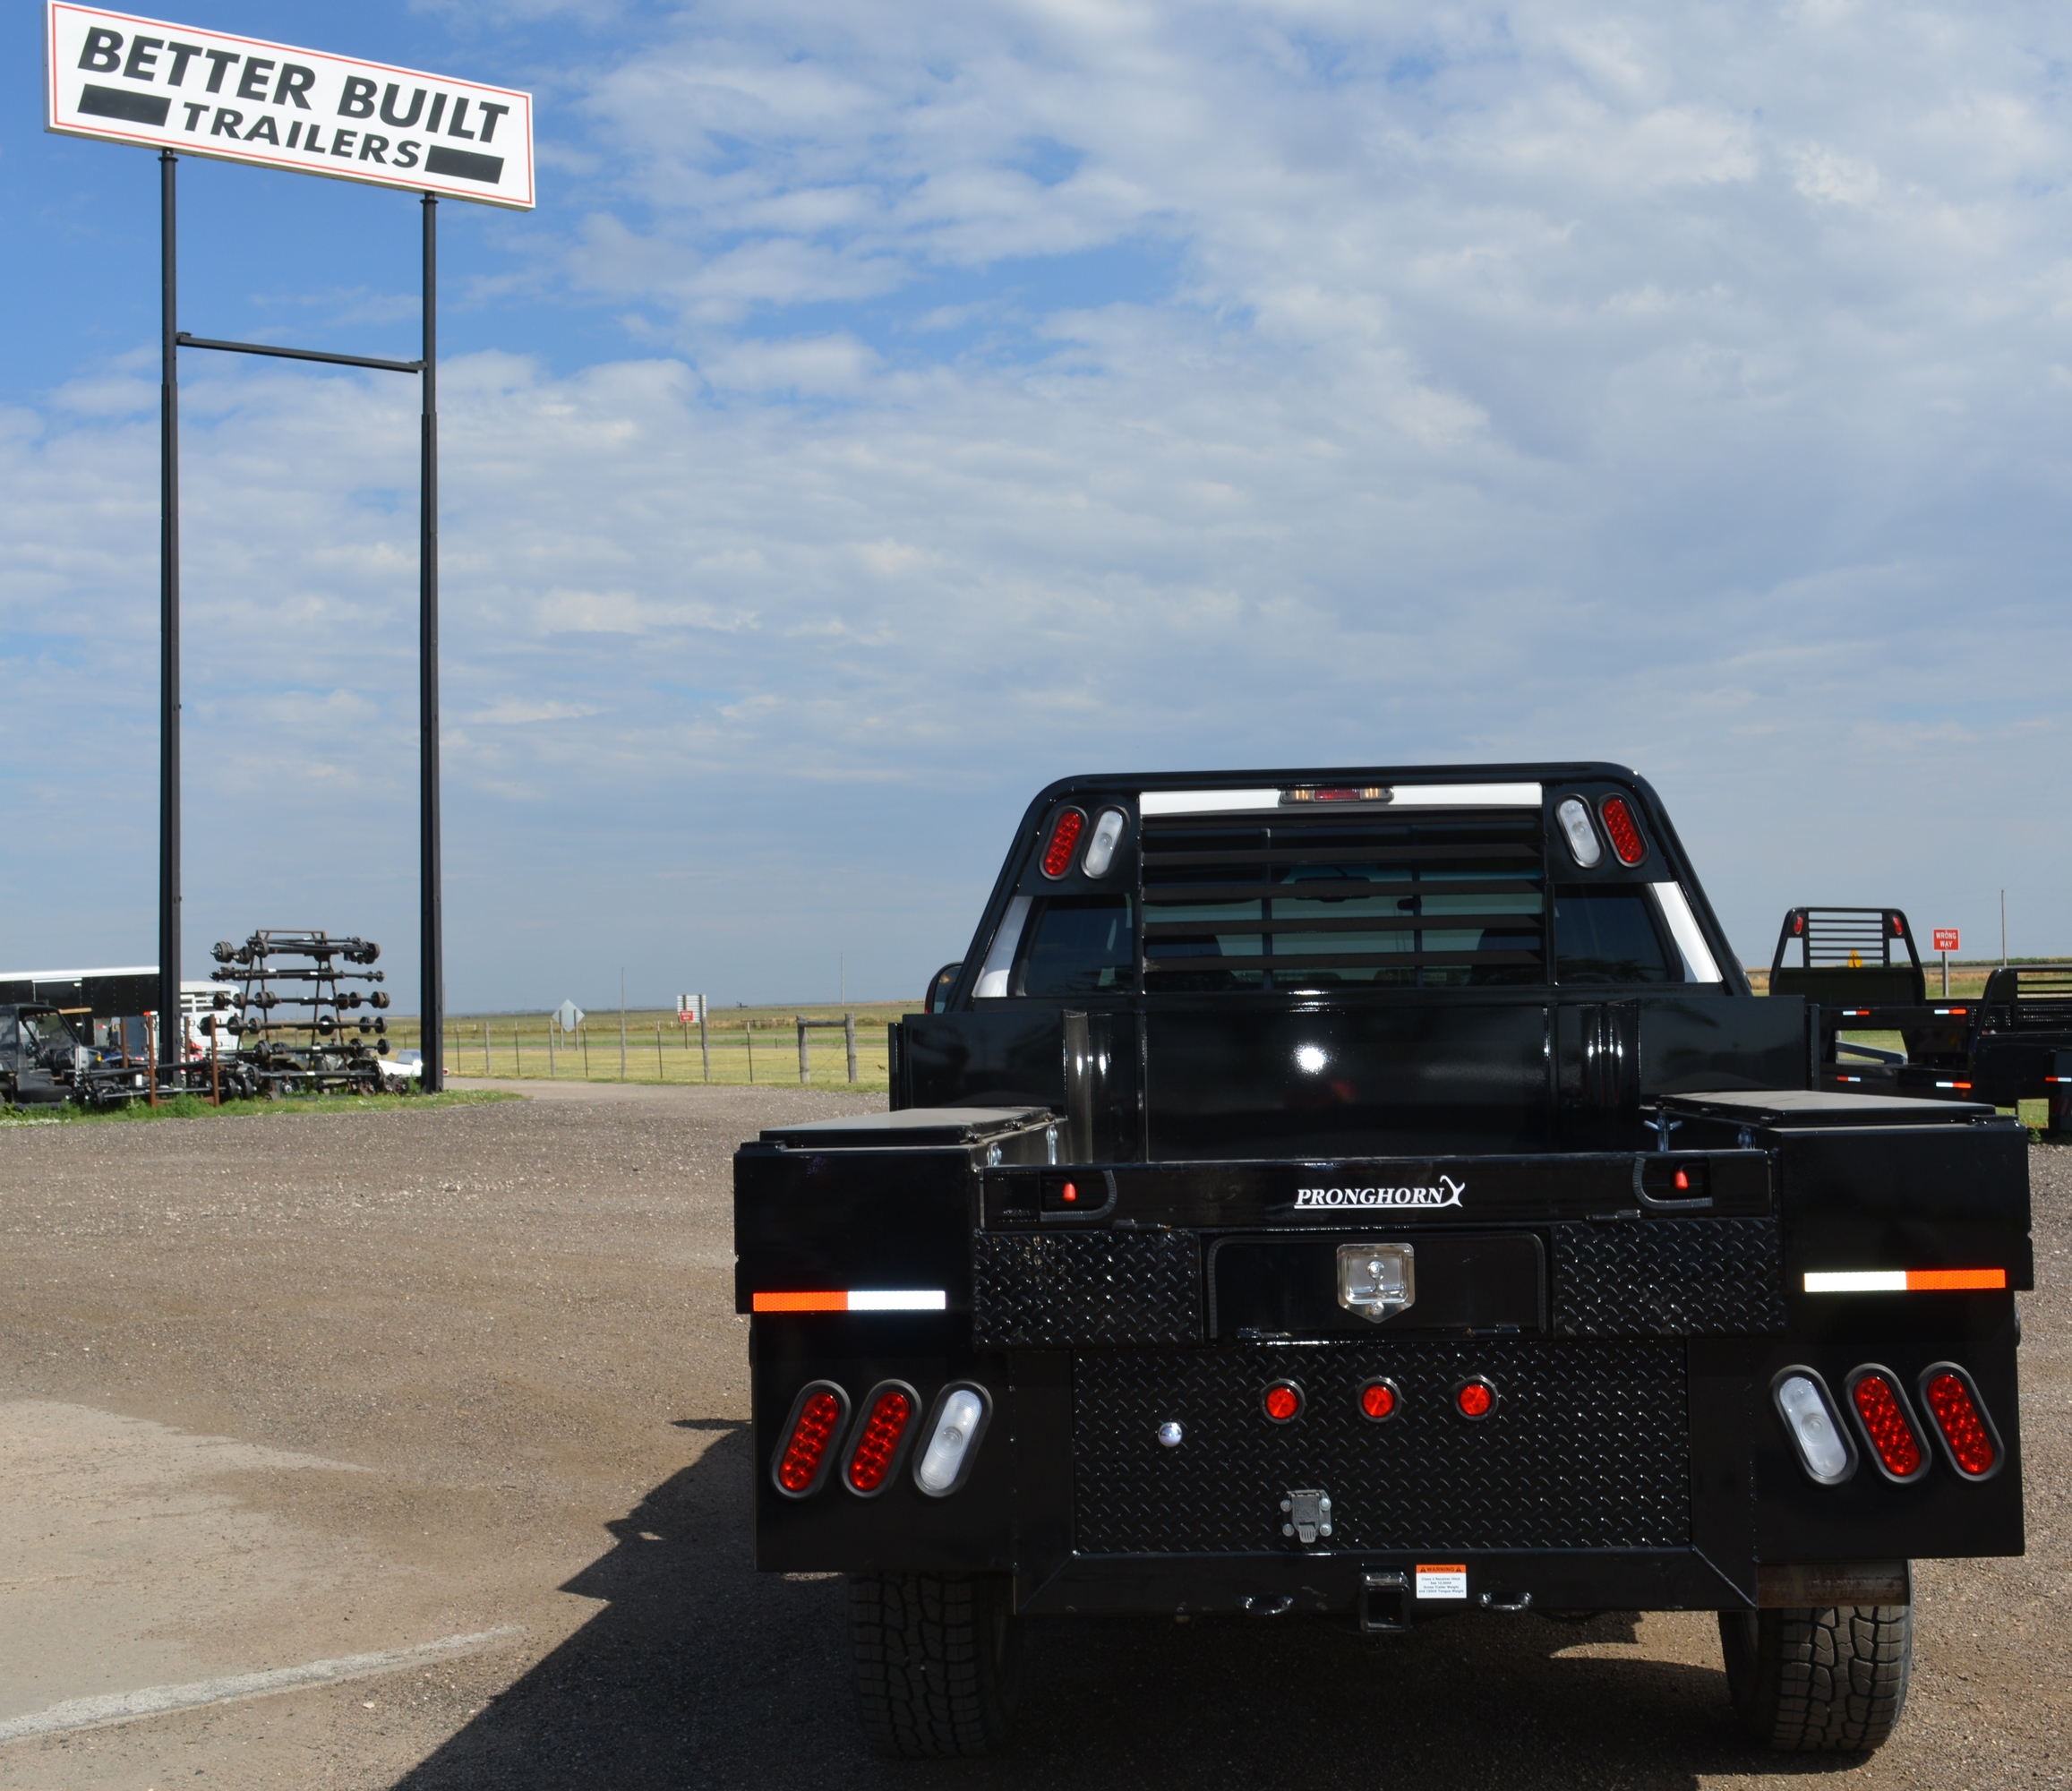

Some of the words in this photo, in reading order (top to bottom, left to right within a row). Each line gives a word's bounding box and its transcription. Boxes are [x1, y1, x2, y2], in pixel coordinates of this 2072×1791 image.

[78, 27, 316, 110] BETTER
[337, 75, 509, 143] BUILT
[184, 101, 423, 168] TRAILERS
[1296, 1187, 1444, 1205] PRONGHORN
